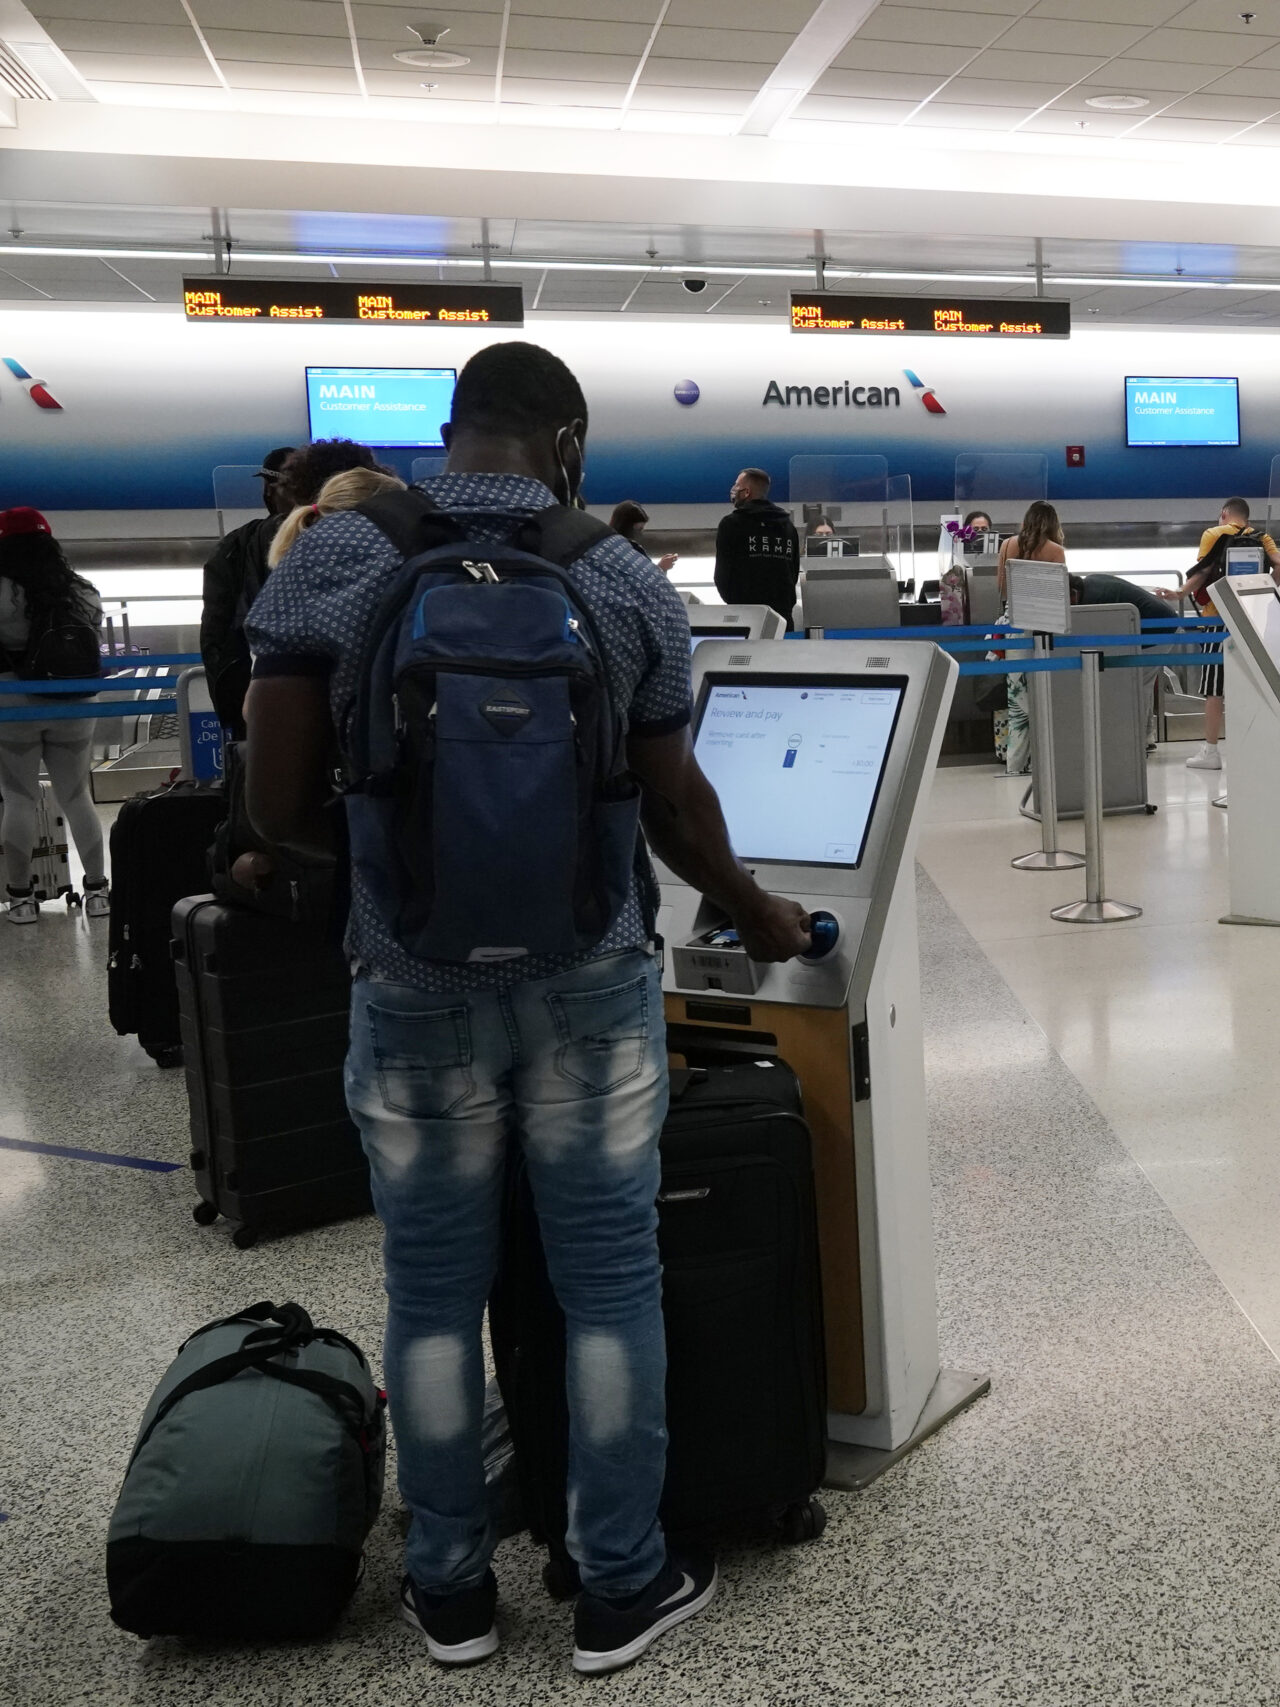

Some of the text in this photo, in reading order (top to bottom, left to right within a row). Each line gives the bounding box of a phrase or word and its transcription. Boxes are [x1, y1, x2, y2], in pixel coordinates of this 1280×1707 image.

[184, 291, 221, 304] MAIN
[358, 295, 392, 308] MAIN
[185, 303, 323, 318] Customer Assist
[359, 307, 489, 321] Customer Assist
[791, 306, 821, 318] MAIN
[933, 310, 962, 322] MAIN
[792, 317, 905, 330] Customer Assist
[934, 320, 1042, 333] Customer Assist
[319, 384, 376, 399] MAIN
[763, 380, 900, 407] American
[1134, 391, 1178, 405] MAIN
[319, 401, 428, 412] Customer Assistance
[1134, 406, 1216, 416] Customer Assistance
[748, 535, 793, 547] KETO
[710, 706, 784, 722] Review and pay
